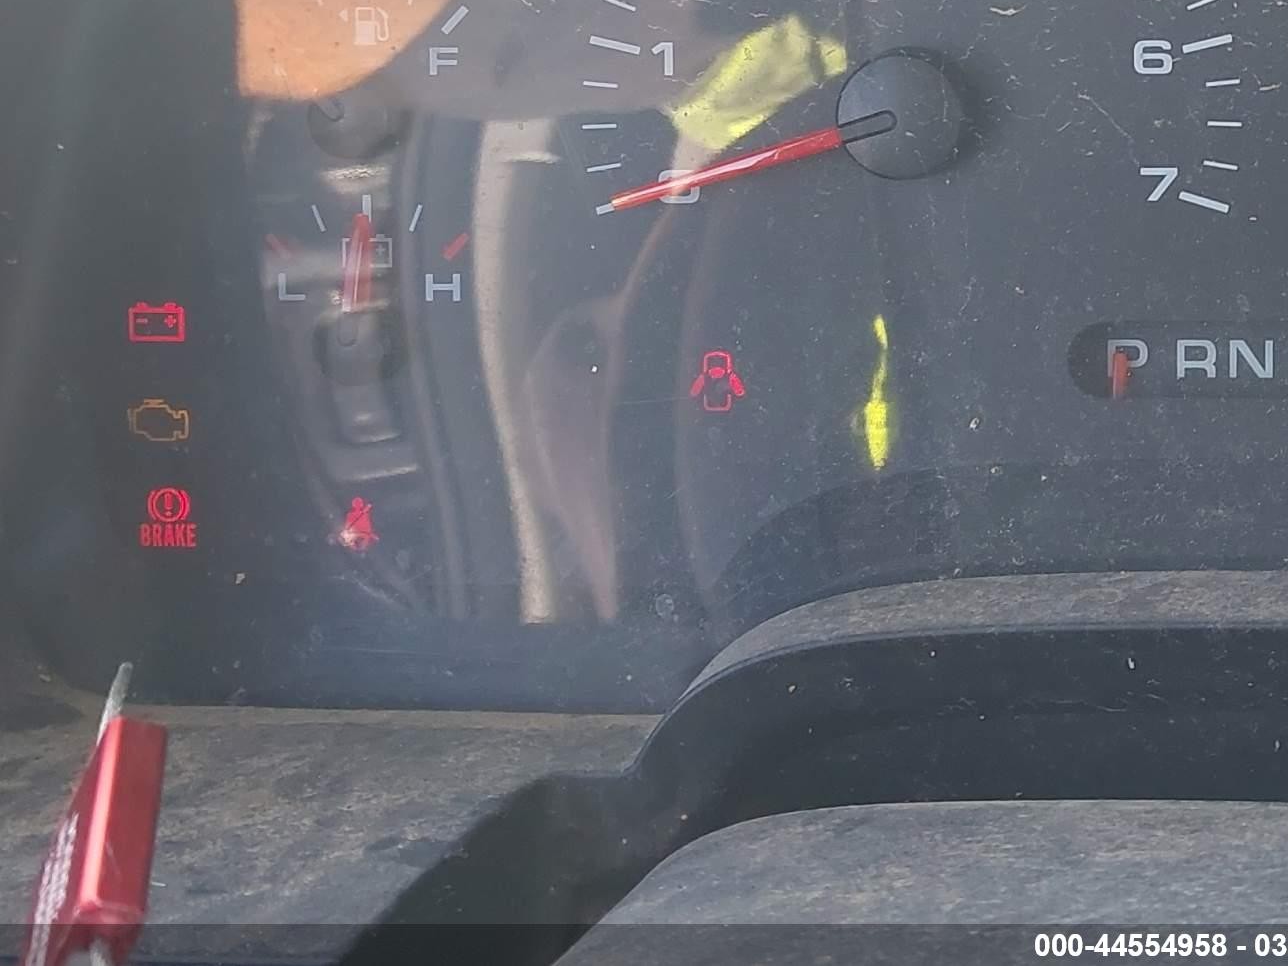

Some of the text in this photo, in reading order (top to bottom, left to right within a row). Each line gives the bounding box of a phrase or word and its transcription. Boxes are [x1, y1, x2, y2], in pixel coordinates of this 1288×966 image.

[429, 47, 459, 76] F
[651, 42, 675, 75] 1
[1133, 41, 1173, 75] 6
[658, 170, 700, 204] 0
[1140, 167, 1179, 202] 7
[278, 274, 306, 301] L
[425, 274, 462, 301] H
[139, 523, 197, 547] BRAKE
